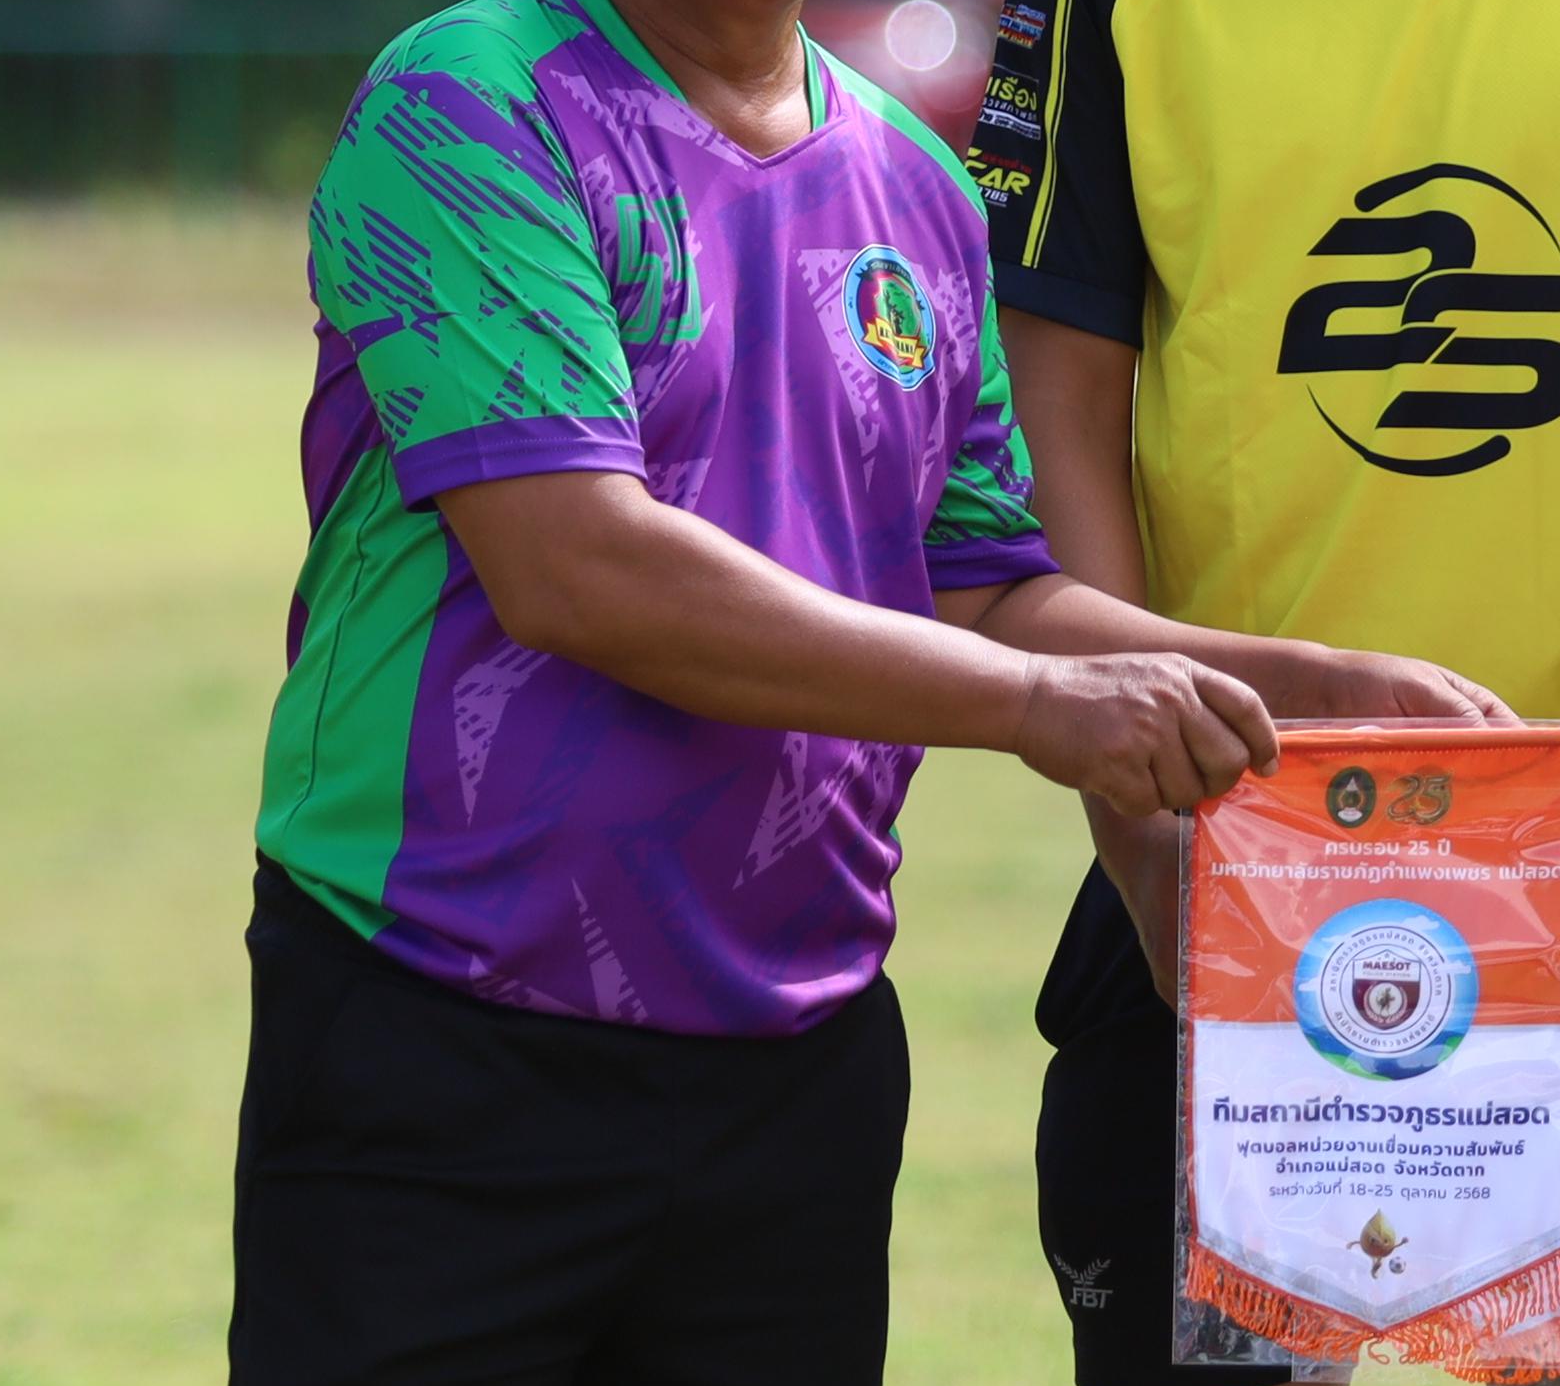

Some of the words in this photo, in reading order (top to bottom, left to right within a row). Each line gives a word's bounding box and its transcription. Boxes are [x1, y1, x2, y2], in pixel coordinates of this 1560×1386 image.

[1324, 841, 1400, 856] ครบรอบ
[1407, 840, 1430, 856] 25
[1437, 838, 1451, 856] ปี
[1362, 961, 1411, 971] MAESOT
[1213, 1095, 1550, 1132] ทีมสถานีตำรวจภูธรแม่สอด
[1276, 1156, 1385, 1174] อำเภอแม่สอด
[1394, 1159, 1485, 1177] จังหวัดตาก
[1269, 1177, 1342, 1196] ระหว่างวันที่
[1349, 1183, 1393, 1197] 18-25
[1400, 1187, 1446, 1201] ตุลาคม
[1454, 1186, 1491, 1200] 2568
[1070, 1286, 1113, 1309] FBT
